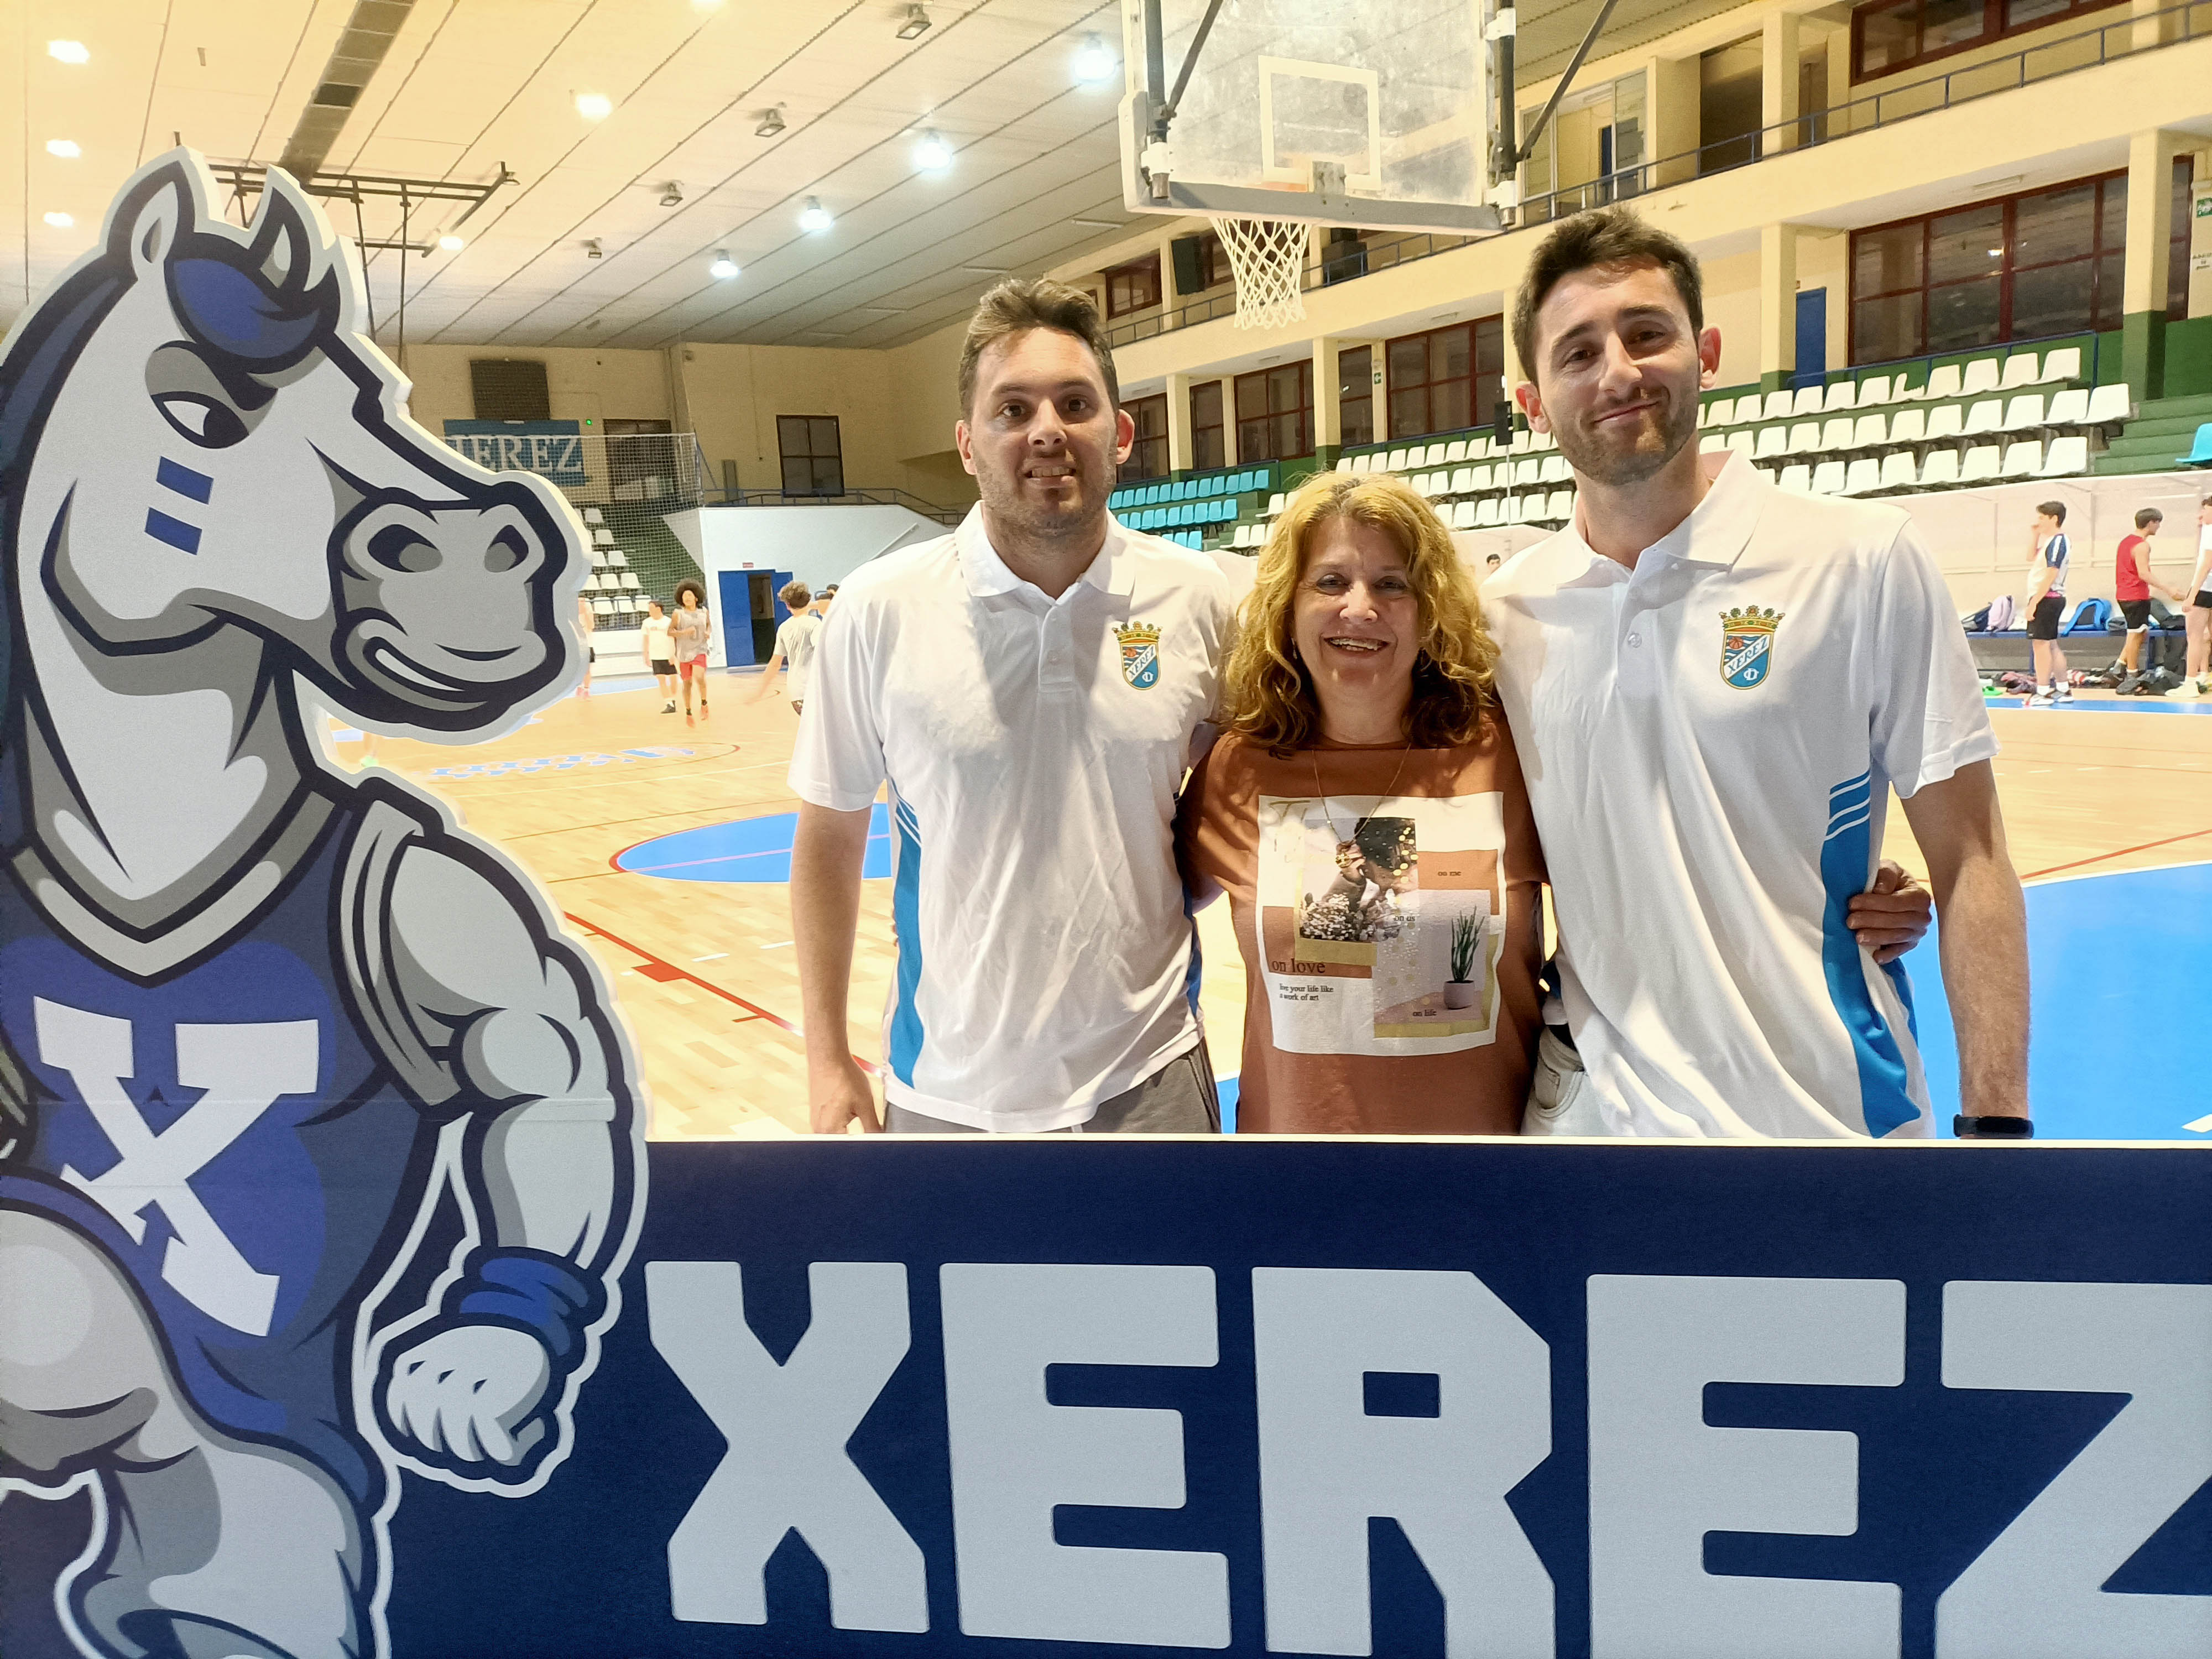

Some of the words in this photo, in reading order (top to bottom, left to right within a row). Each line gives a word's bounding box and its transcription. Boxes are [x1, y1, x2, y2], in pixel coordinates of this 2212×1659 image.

[1728, 636, 1768, 675] XEREZ
[1272, 961, 1286, 972] on
[1291, 958, 1326, 973] love
[34, 995, 319, 1337] X
[644, 1261, 2212, 1659] XEREZ
